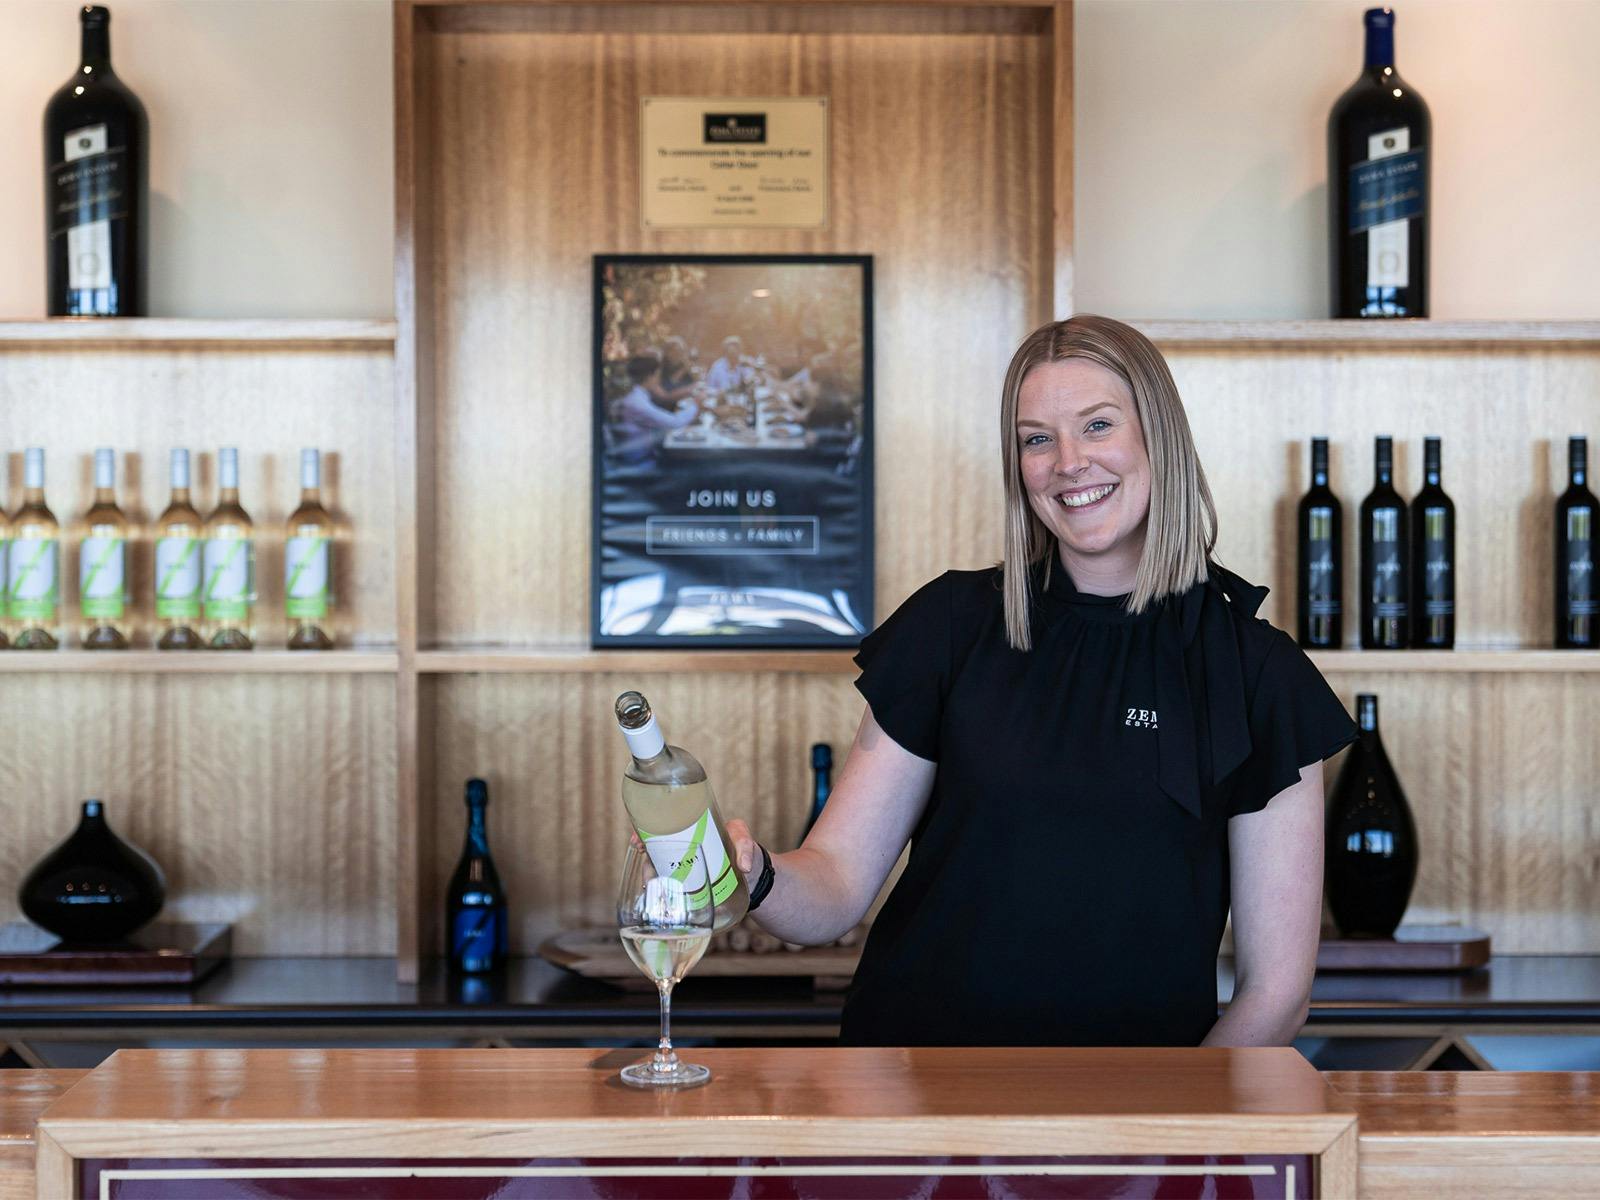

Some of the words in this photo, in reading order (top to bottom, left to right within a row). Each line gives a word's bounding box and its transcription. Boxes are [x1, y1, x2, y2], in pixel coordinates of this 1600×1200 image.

[686, 489, 739, 508] JOIN
[745, 489, 777, 508] US
[662, 527, 730, 543] FRIENDS
[746, 527, 805, 543] FAMILY
